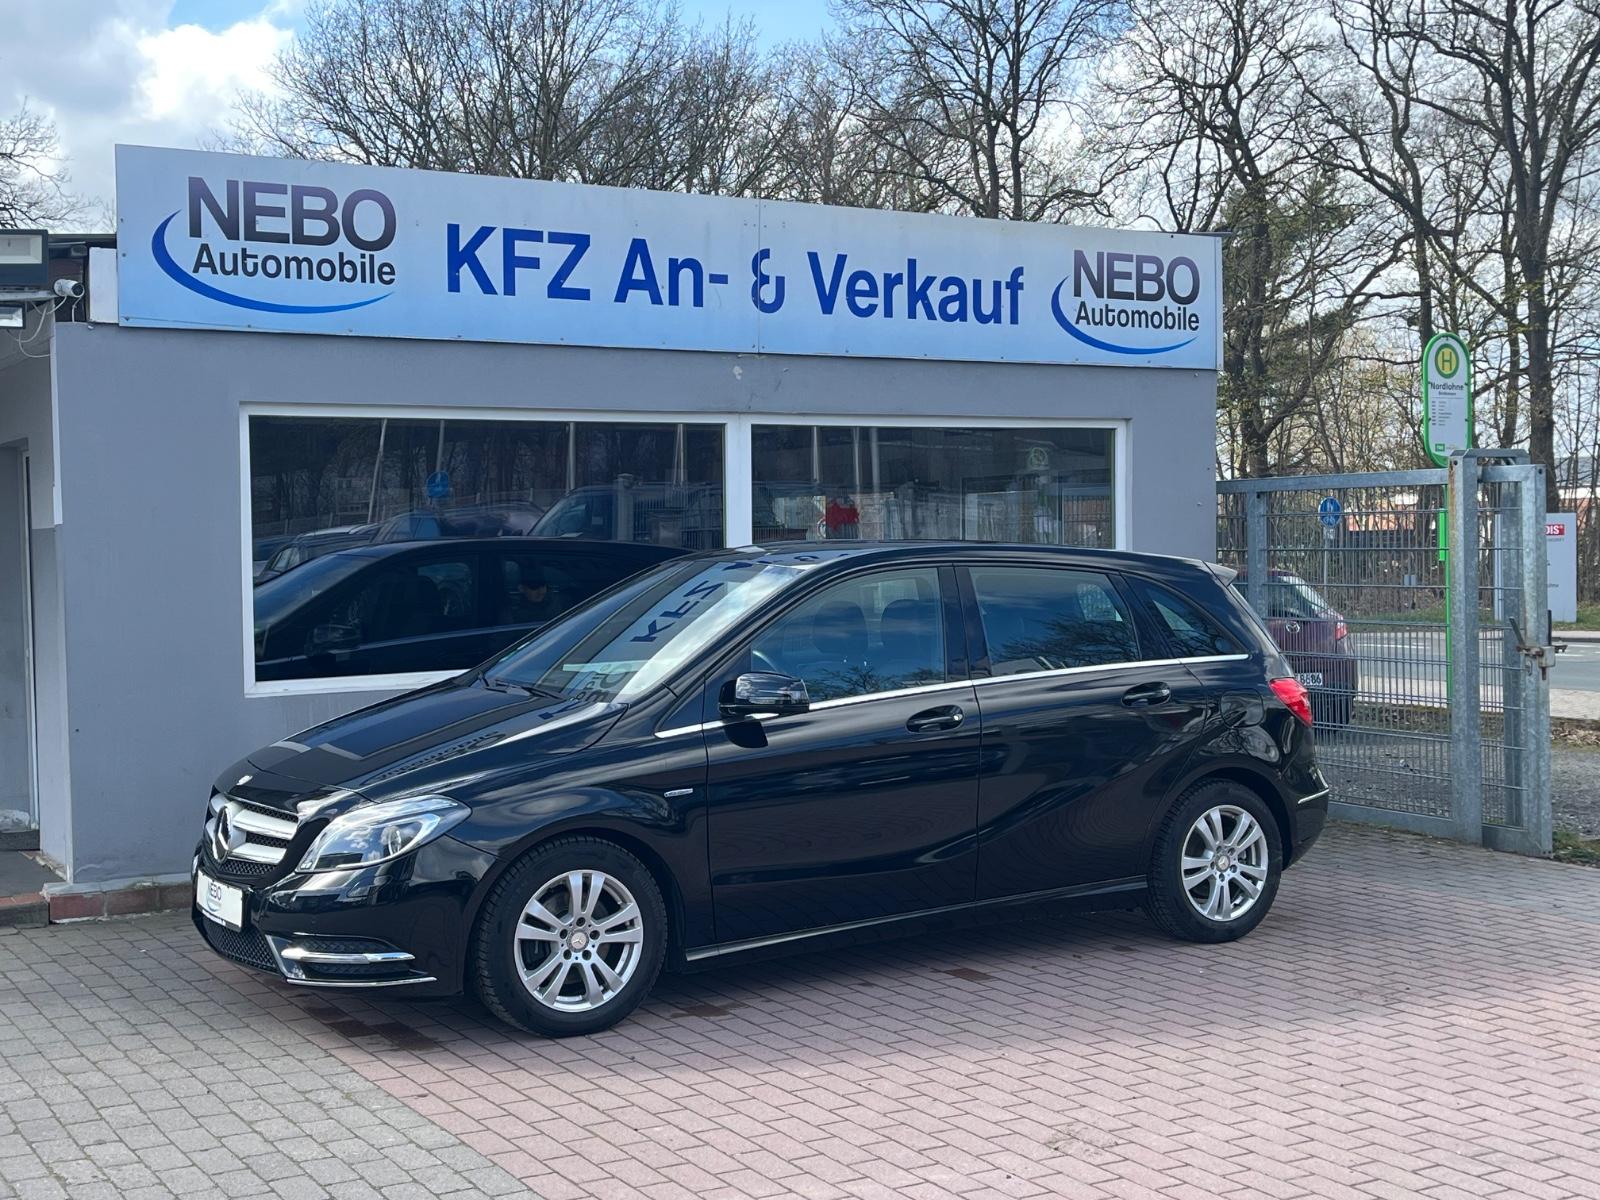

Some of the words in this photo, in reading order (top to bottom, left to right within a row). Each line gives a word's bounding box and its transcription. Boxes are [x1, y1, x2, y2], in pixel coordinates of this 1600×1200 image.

[188, 176, 396, 252] NEBO
[193, 243, 396, 285] Automobile
[447, 223, 591, 301] KFZ
[613, 238, 728, 308] An-
[751, 248, 785, 313] &
[807, 251, 1024, 325] Verkauf
[1073, 250, 1200, 305] NEBO
[1075, 301, 1200, 331] Automobile
[1441, 351, 1453, 372] H
